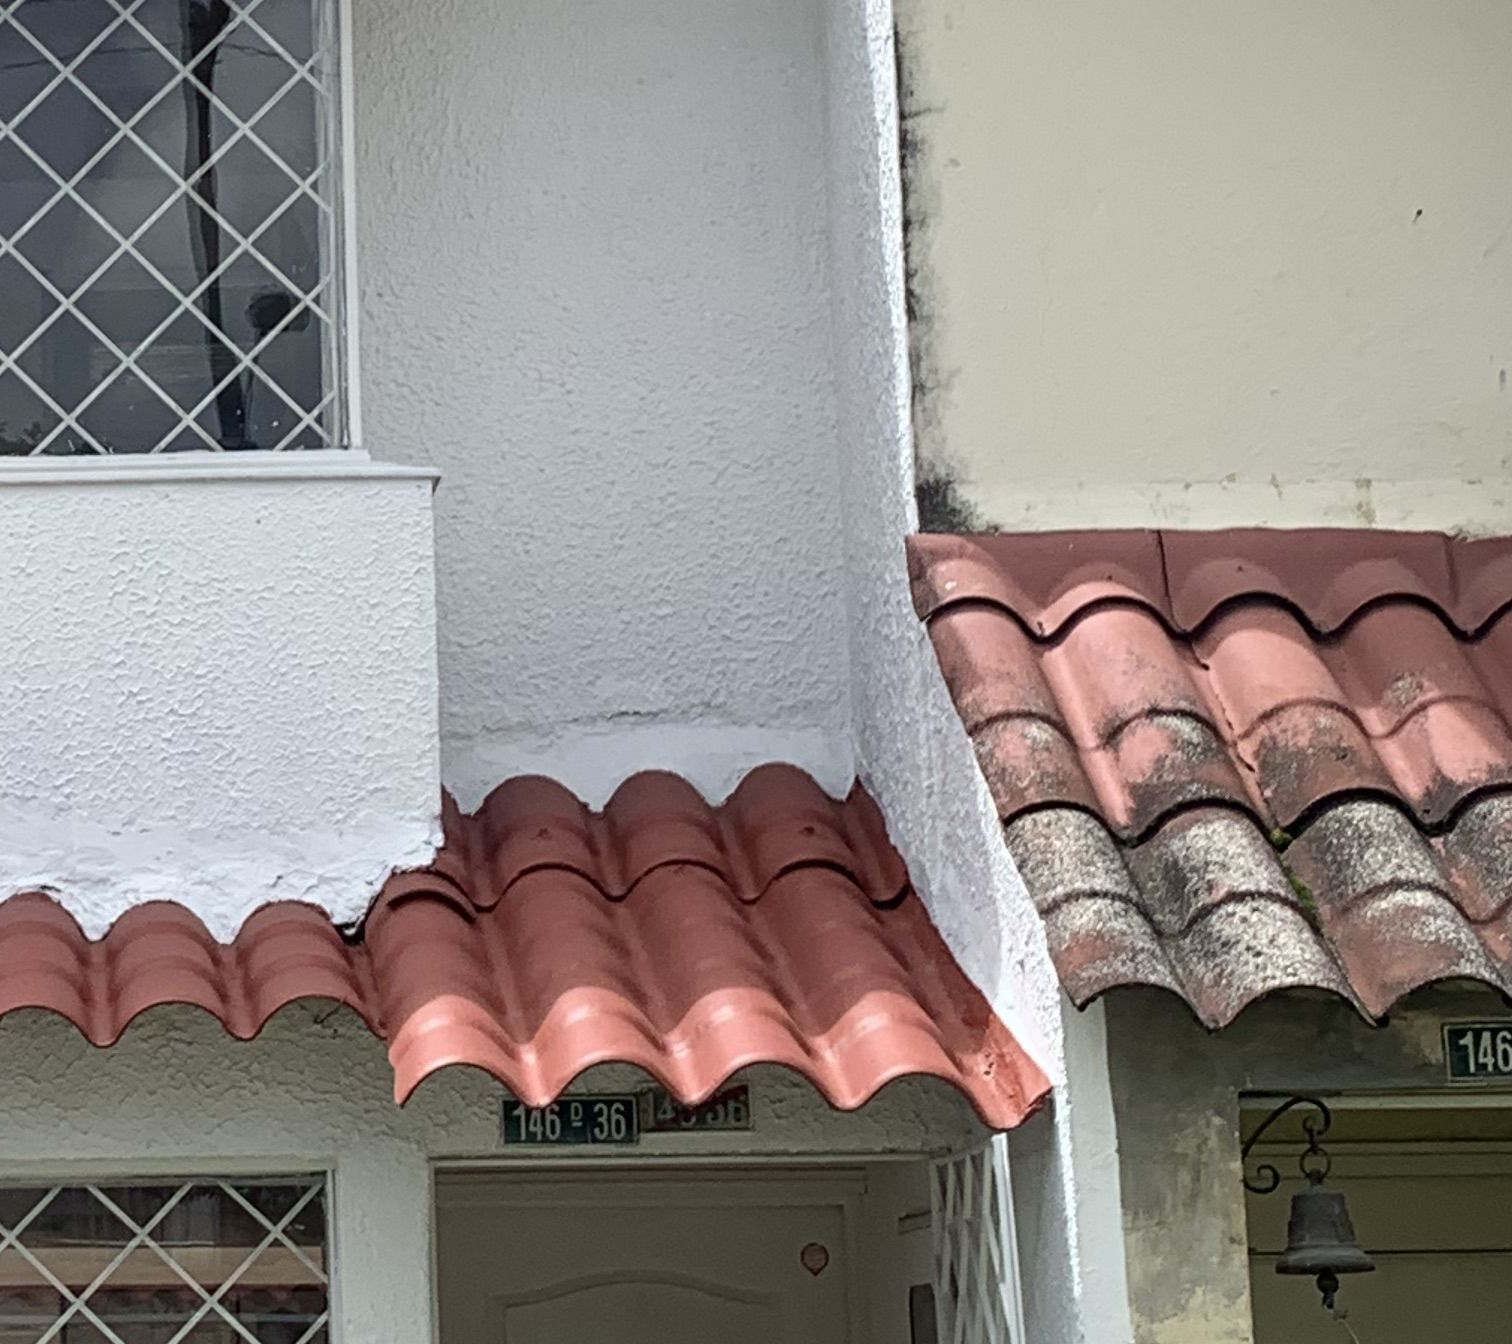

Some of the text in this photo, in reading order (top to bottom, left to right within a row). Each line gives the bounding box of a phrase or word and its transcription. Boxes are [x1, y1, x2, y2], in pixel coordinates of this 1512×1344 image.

[1458, 1030, 1512, 1074] 146
[511, 1103, 561, 1142] 146
[593, 1102, 627, 1140] 36
